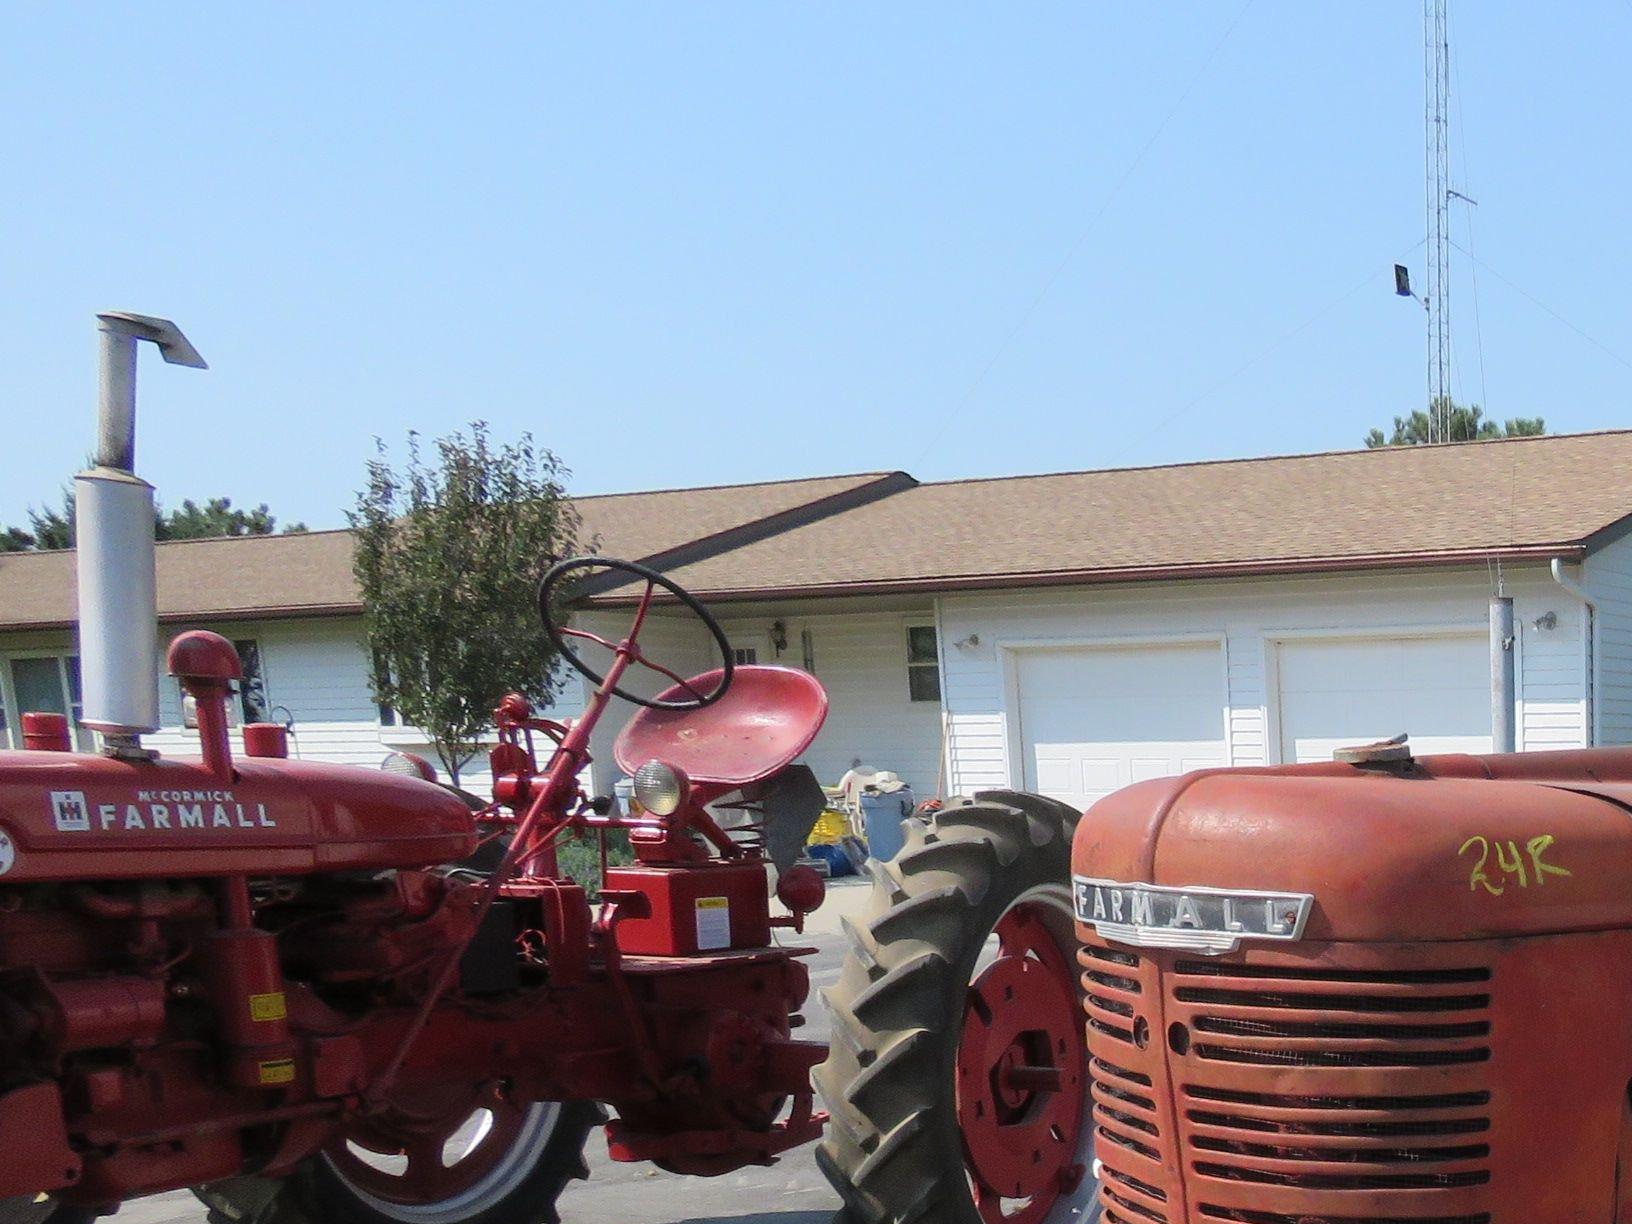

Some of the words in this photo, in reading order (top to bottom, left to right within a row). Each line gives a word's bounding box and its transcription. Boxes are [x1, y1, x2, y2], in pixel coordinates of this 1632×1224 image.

[98, 803, 277, 830] FARMALL
[1457, 834, 1573, 896] 24R
[1077, 885, 1286, 935] FARMALL
